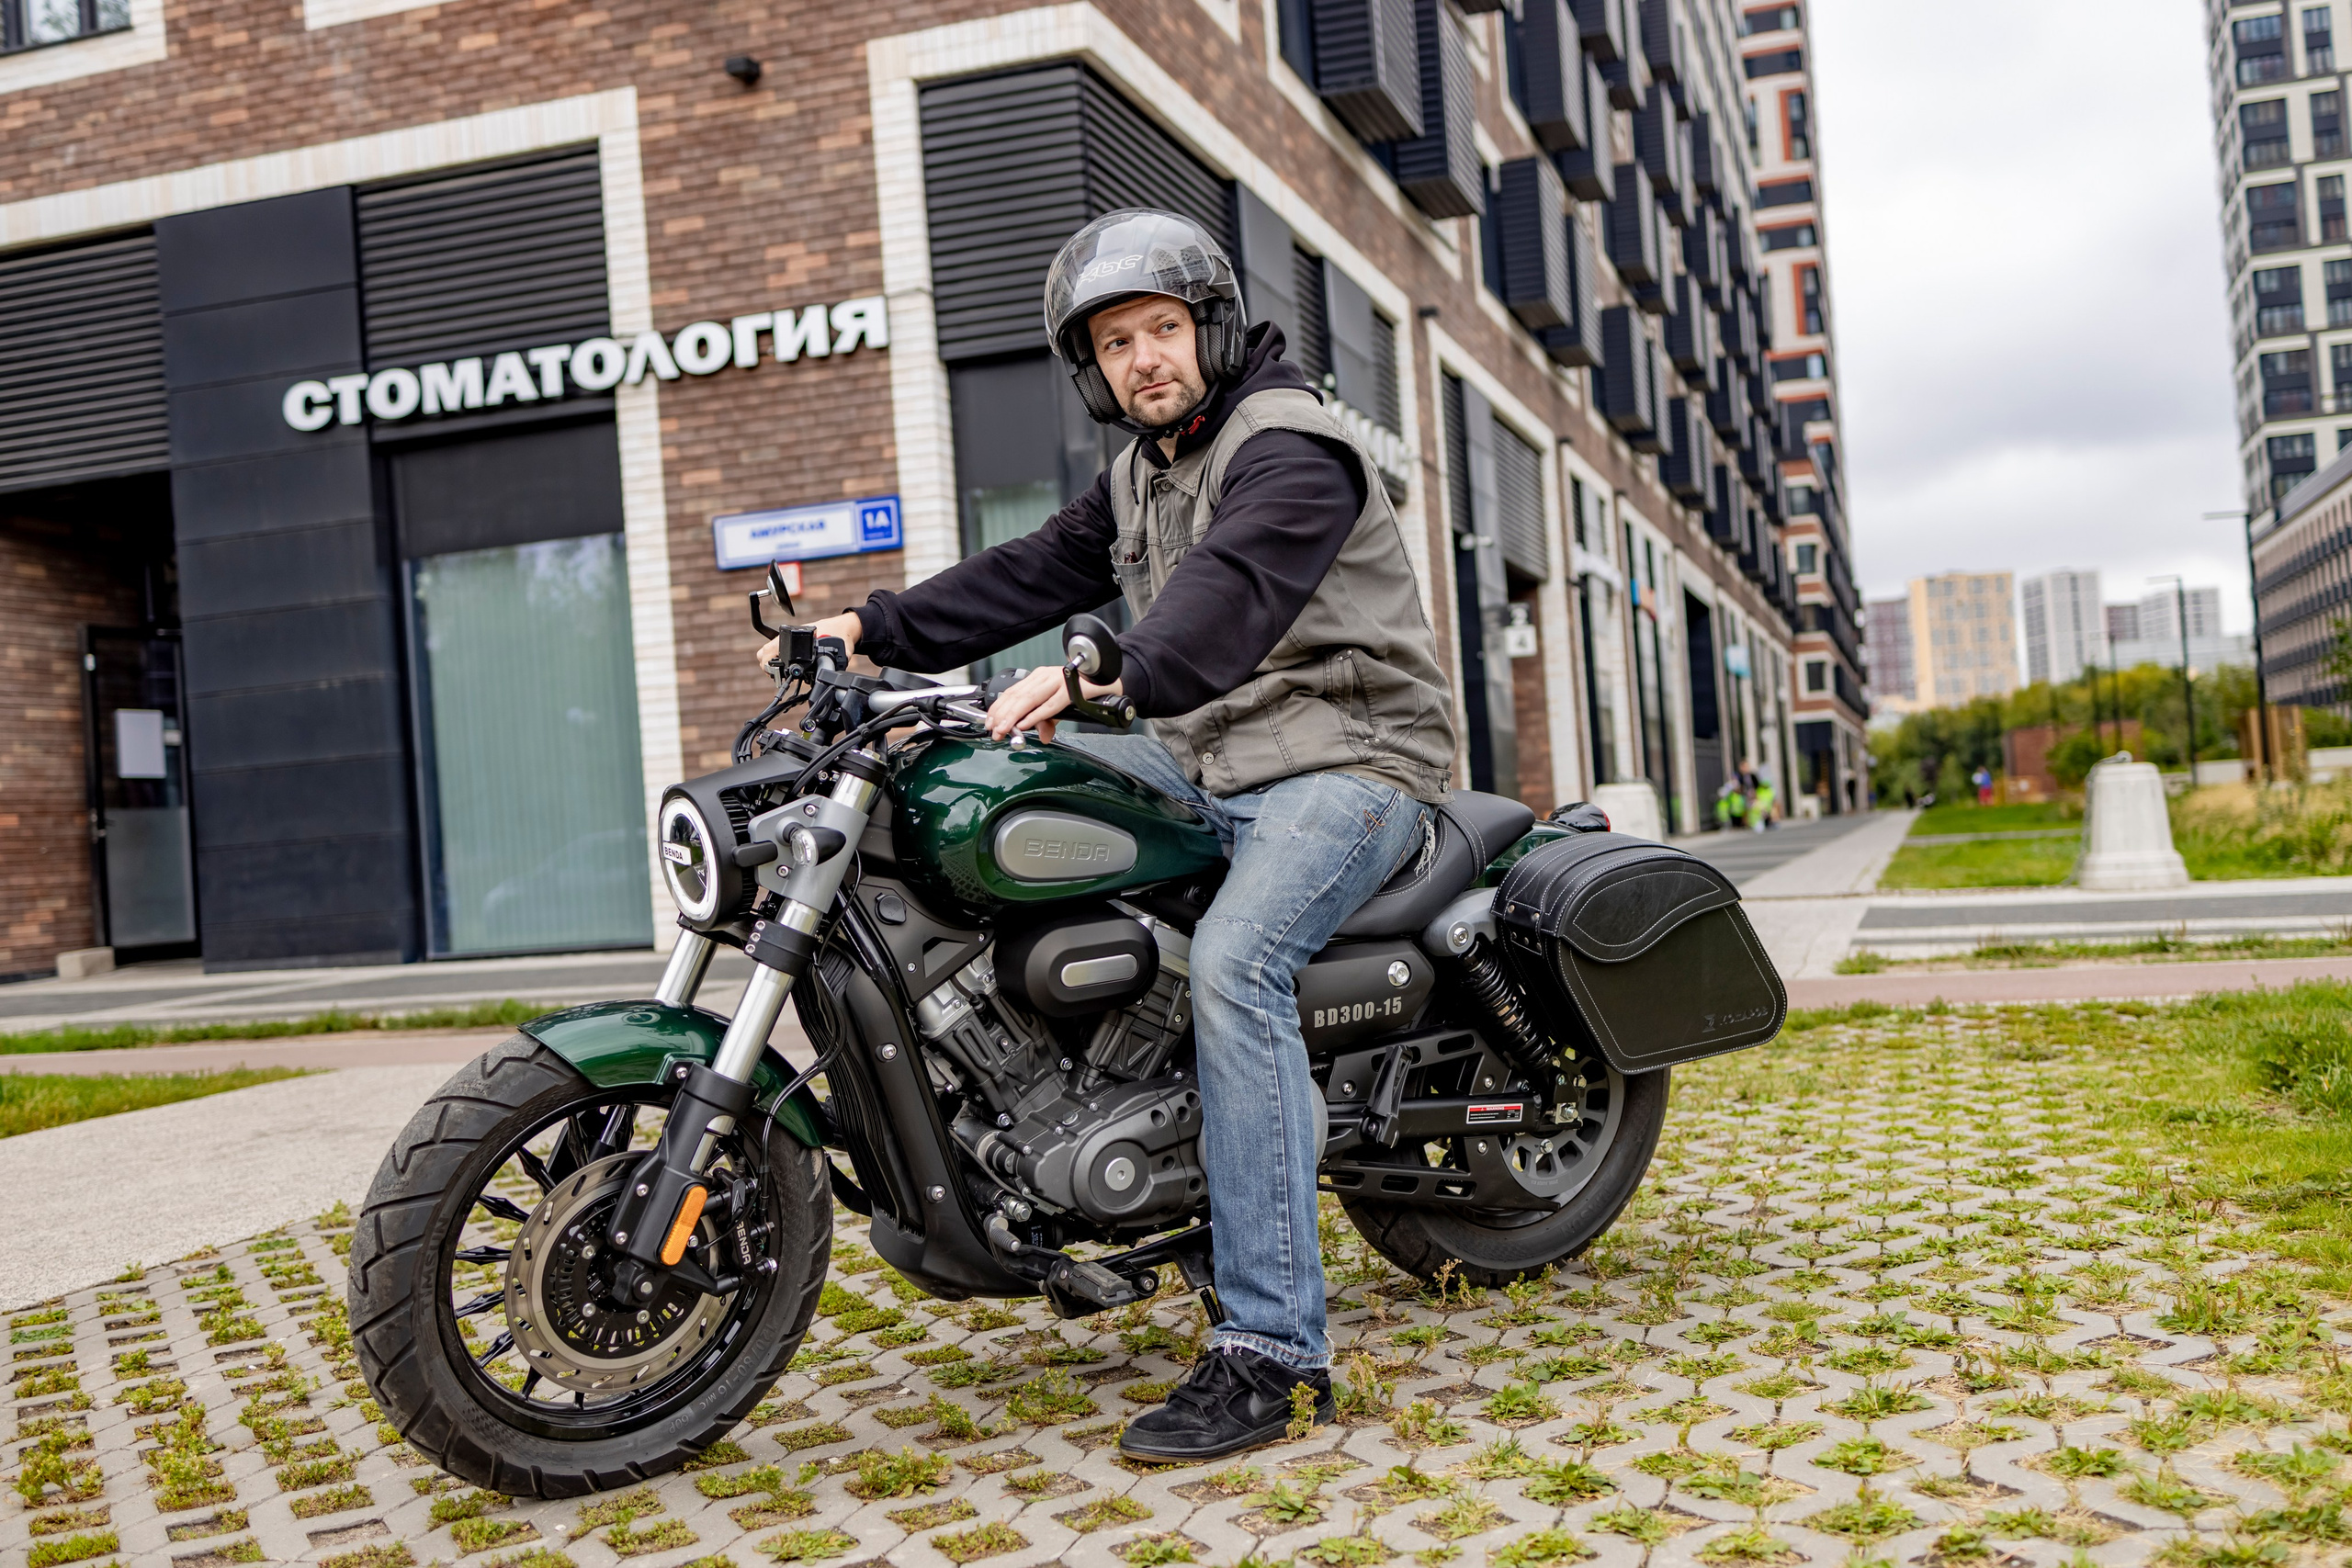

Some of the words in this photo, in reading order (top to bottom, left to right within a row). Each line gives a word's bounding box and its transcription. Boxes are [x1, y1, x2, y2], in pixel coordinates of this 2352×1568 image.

[282, 295, 889, 431] СТОМАТОЛОГИЯ
[865, 510, 890, 529] 1А
[664, 846, 684, 862] BENDA
[1023, 838, 1111, 862] BENDA
[1314, 997, 1402, 1028] BD300-15
[718, 1321, 777, 1397] 120/80-16
[697, 1392, 718, 1411] M/C
[668, 1414, 690, 1434] 60P
